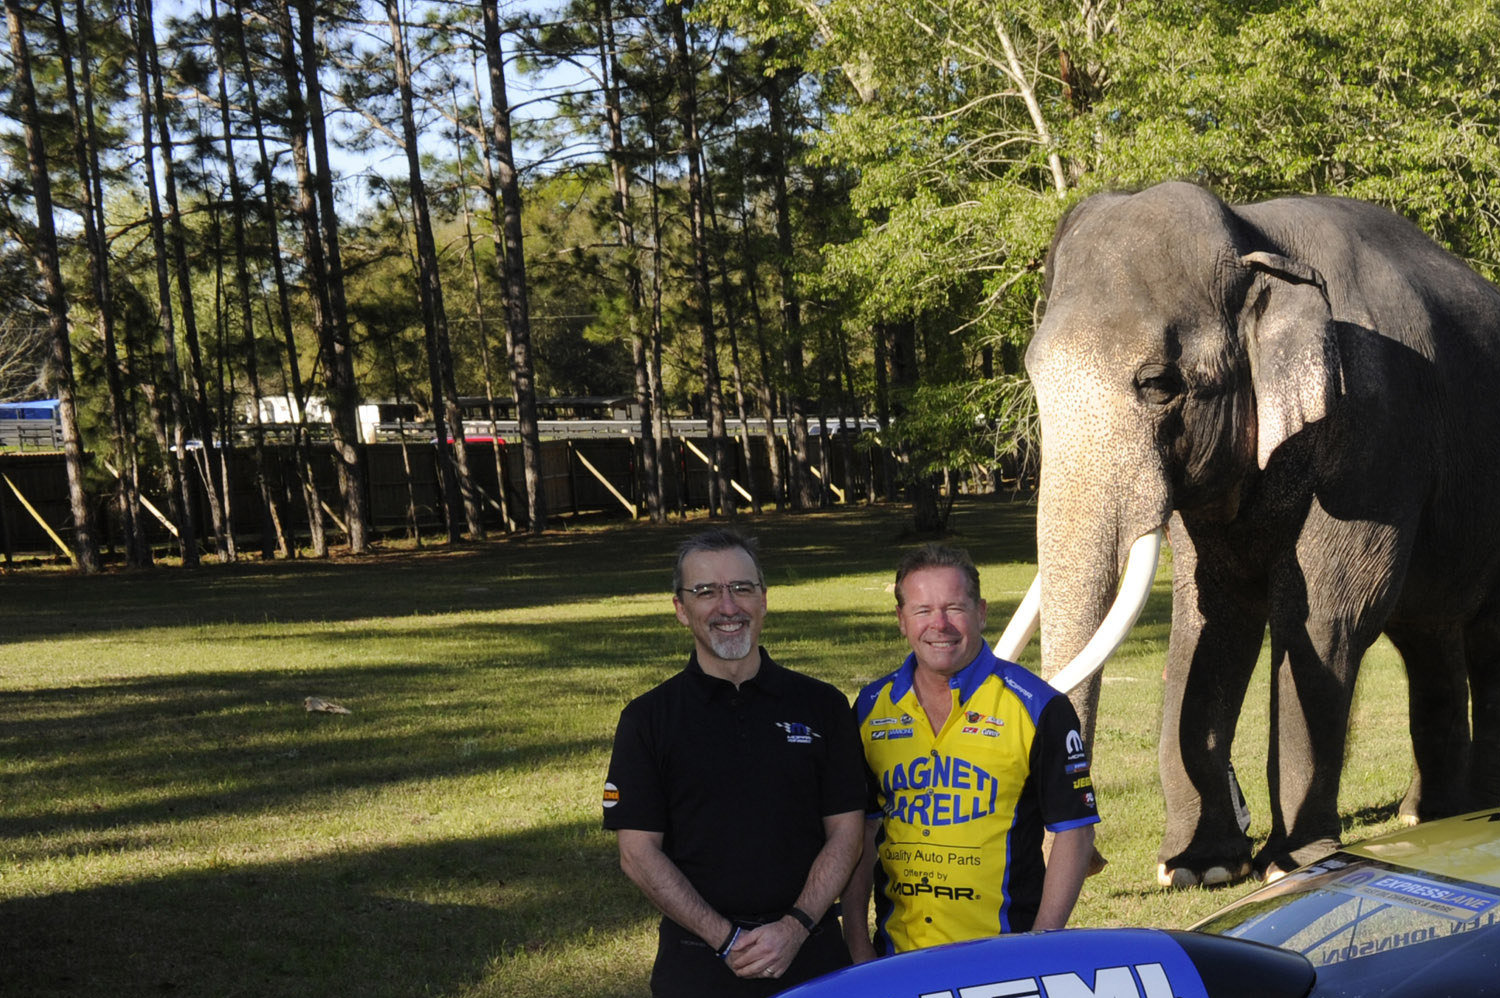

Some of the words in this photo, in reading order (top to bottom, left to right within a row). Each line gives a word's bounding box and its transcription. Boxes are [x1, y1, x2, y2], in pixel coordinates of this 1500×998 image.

[885, 848, 912, 864] Quality
[914, 850, 943, 863] Auto
[948, 852, 981, 866] Parts
[904, 868, 934, 879] Offered
[937, 871, 948, 881] by
